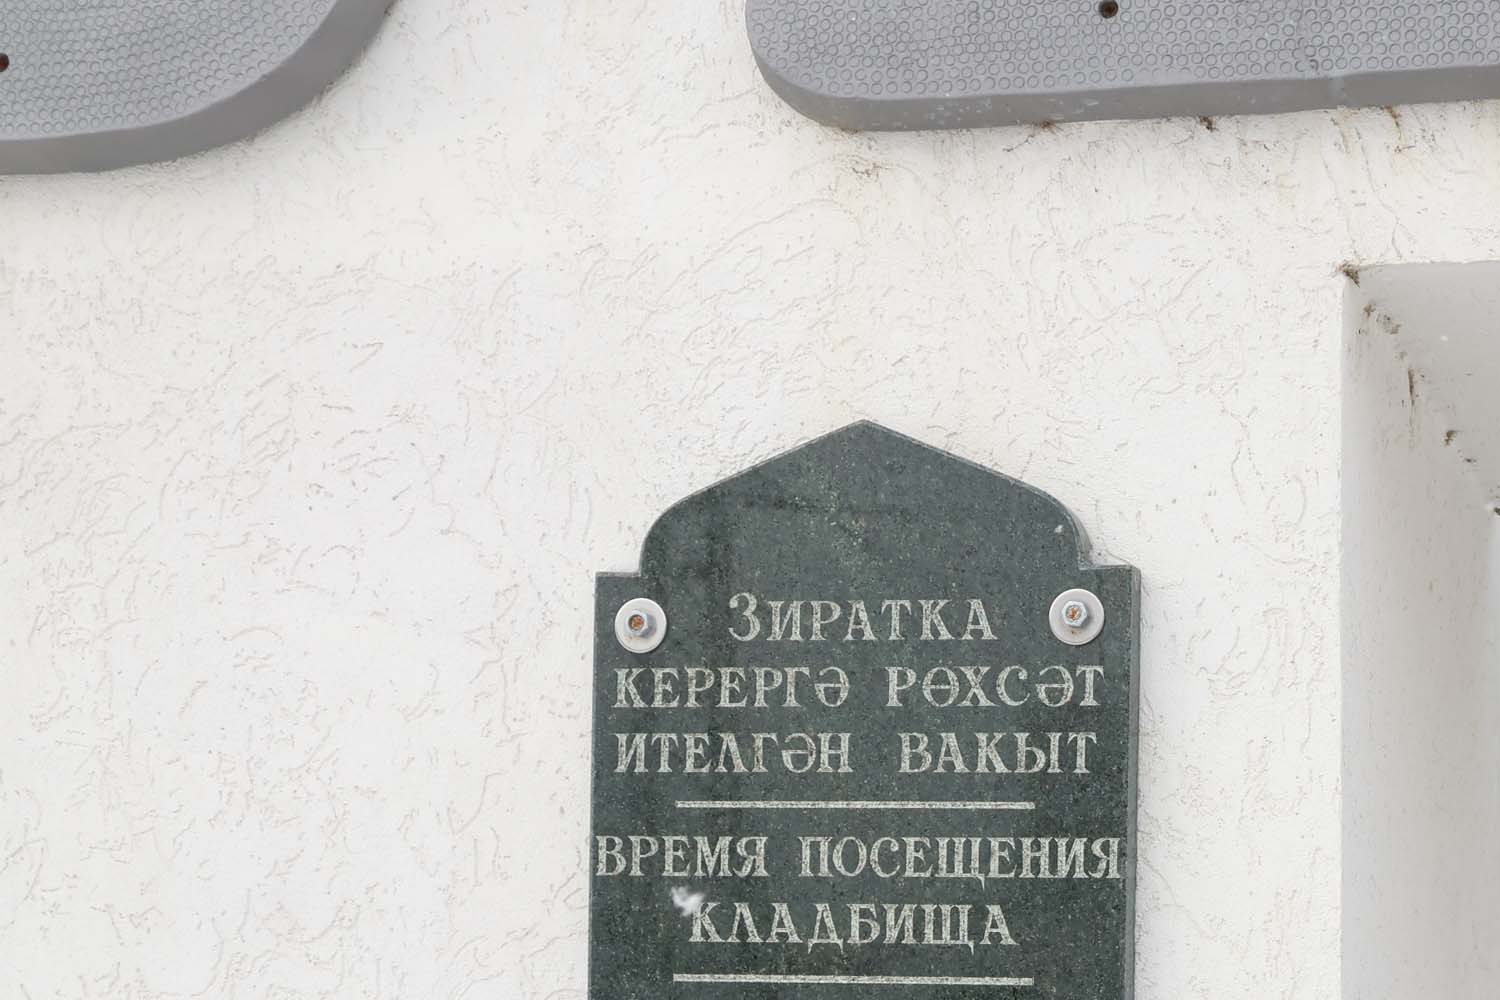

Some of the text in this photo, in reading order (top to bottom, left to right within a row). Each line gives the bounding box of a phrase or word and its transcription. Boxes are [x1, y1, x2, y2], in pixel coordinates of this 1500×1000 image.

[728, 592, 998, 641] ЗИРАТКА
[613, 664, 1104, 708] КЕРЕРГӘ РӨХСӘТ
[612, 731, 1098, 774] ИТЕЛГӘН ВАКЫТ
[595, 835, 1122, 887] ВРЕМЯ ПОСЕЩЕНИЯ
[687, 902, 1019, 955] КЛАДБИЩА
